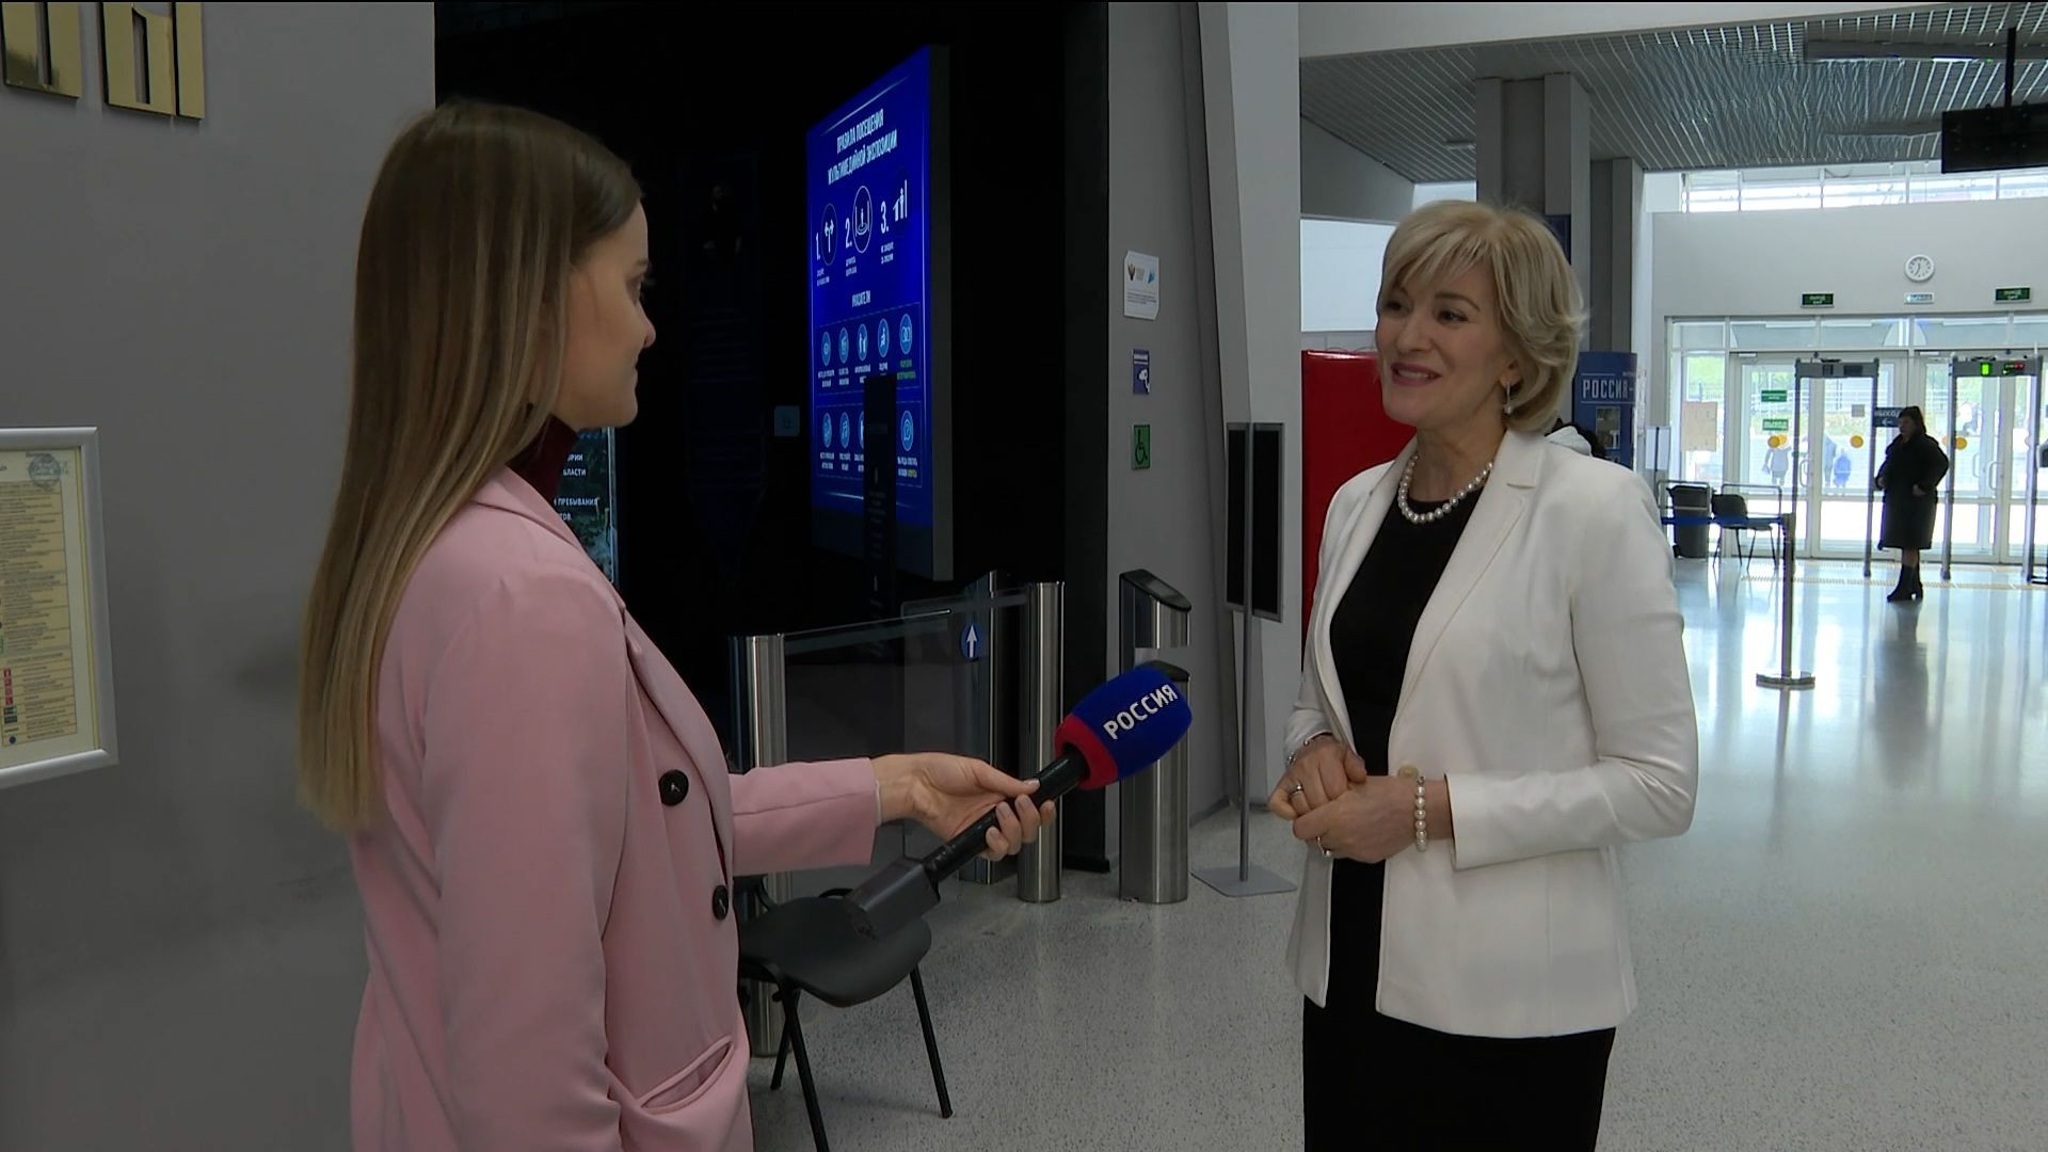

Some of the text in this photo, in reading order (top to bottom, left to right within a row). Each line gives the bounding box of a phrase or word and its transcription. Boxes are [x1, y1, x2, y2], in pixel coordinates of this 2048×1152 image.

[845, 217, 852, 248] 2.
[880, 201, 889, 234] 3.
[1103, 684, 1178, 740] РОССИЯ
